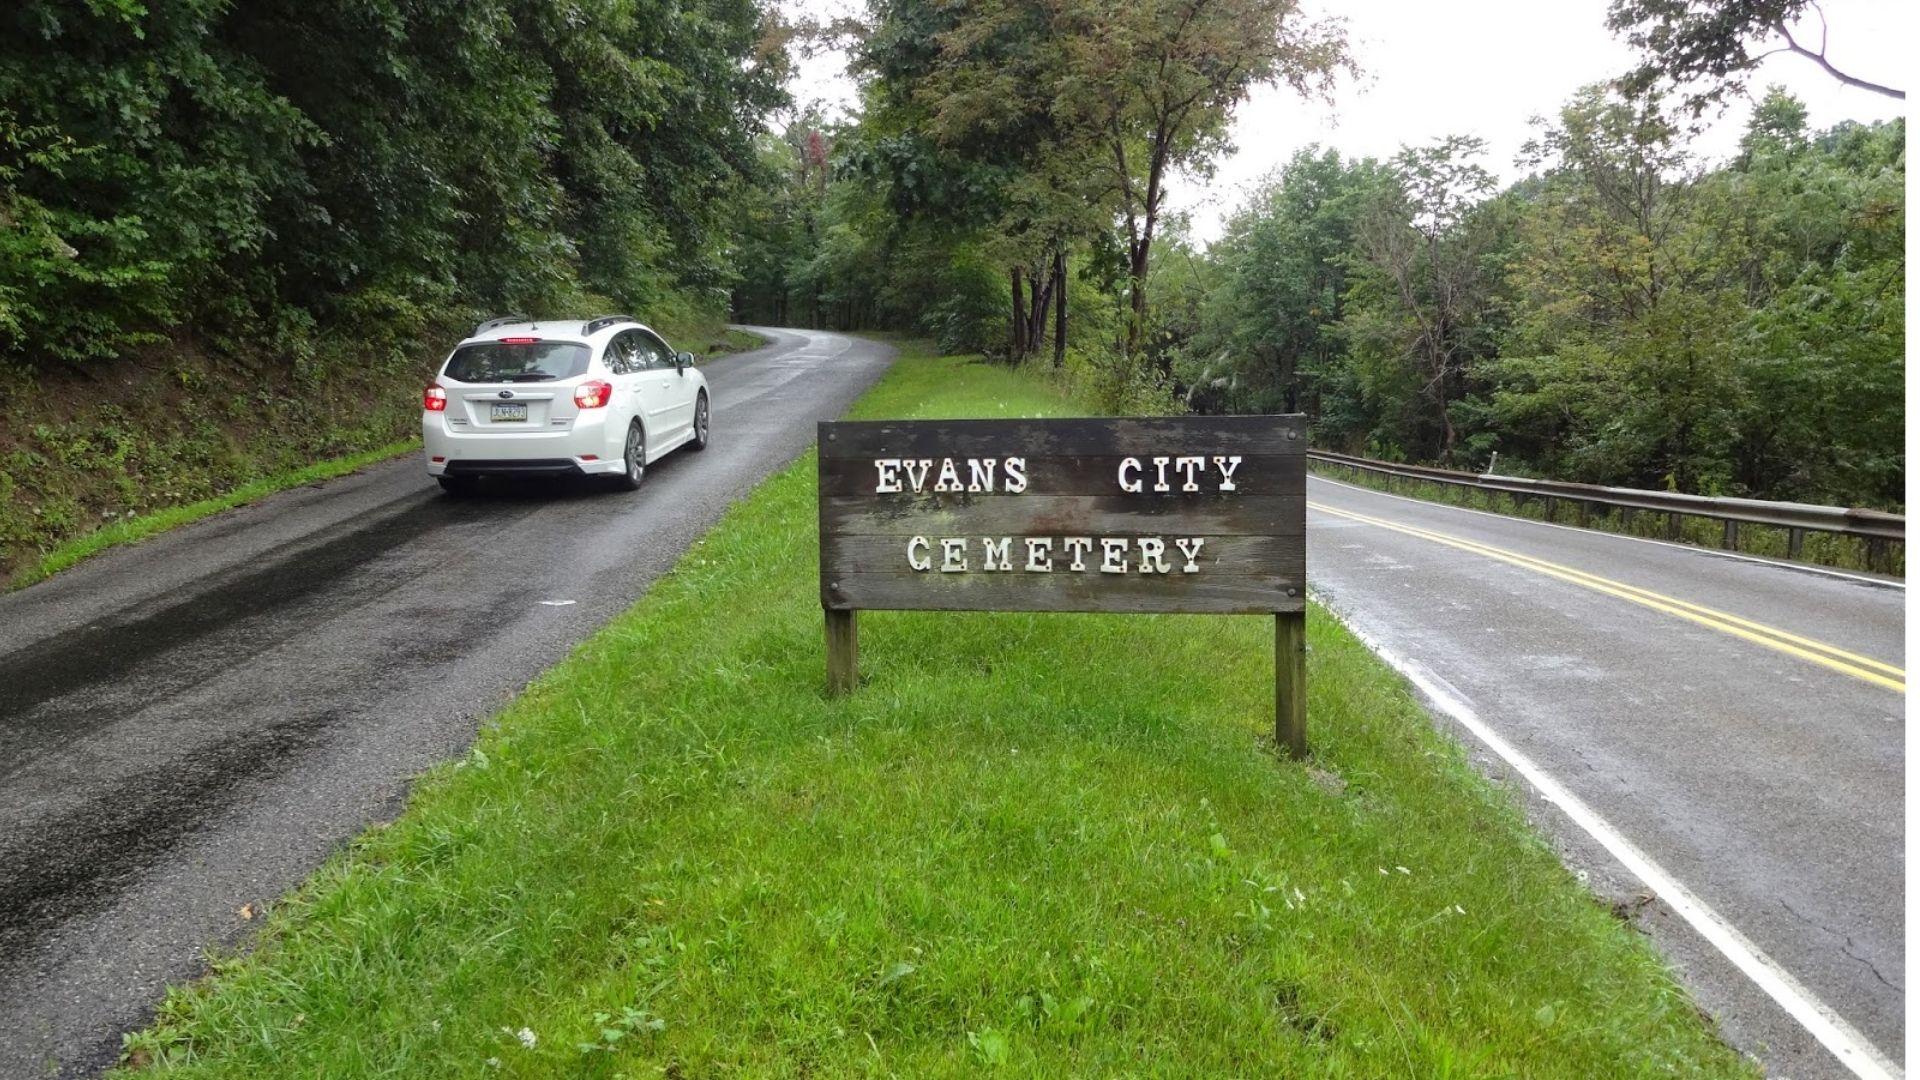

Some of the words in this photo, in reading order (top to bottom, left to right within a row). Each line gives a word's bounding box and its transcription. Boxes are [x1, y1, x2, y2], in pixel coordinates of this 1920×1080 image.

[874, 457, 1028, 495] EVANS
[1117, 456, 1243, 493] CITY
[906, 536, 1205, 574] CEMETERY
